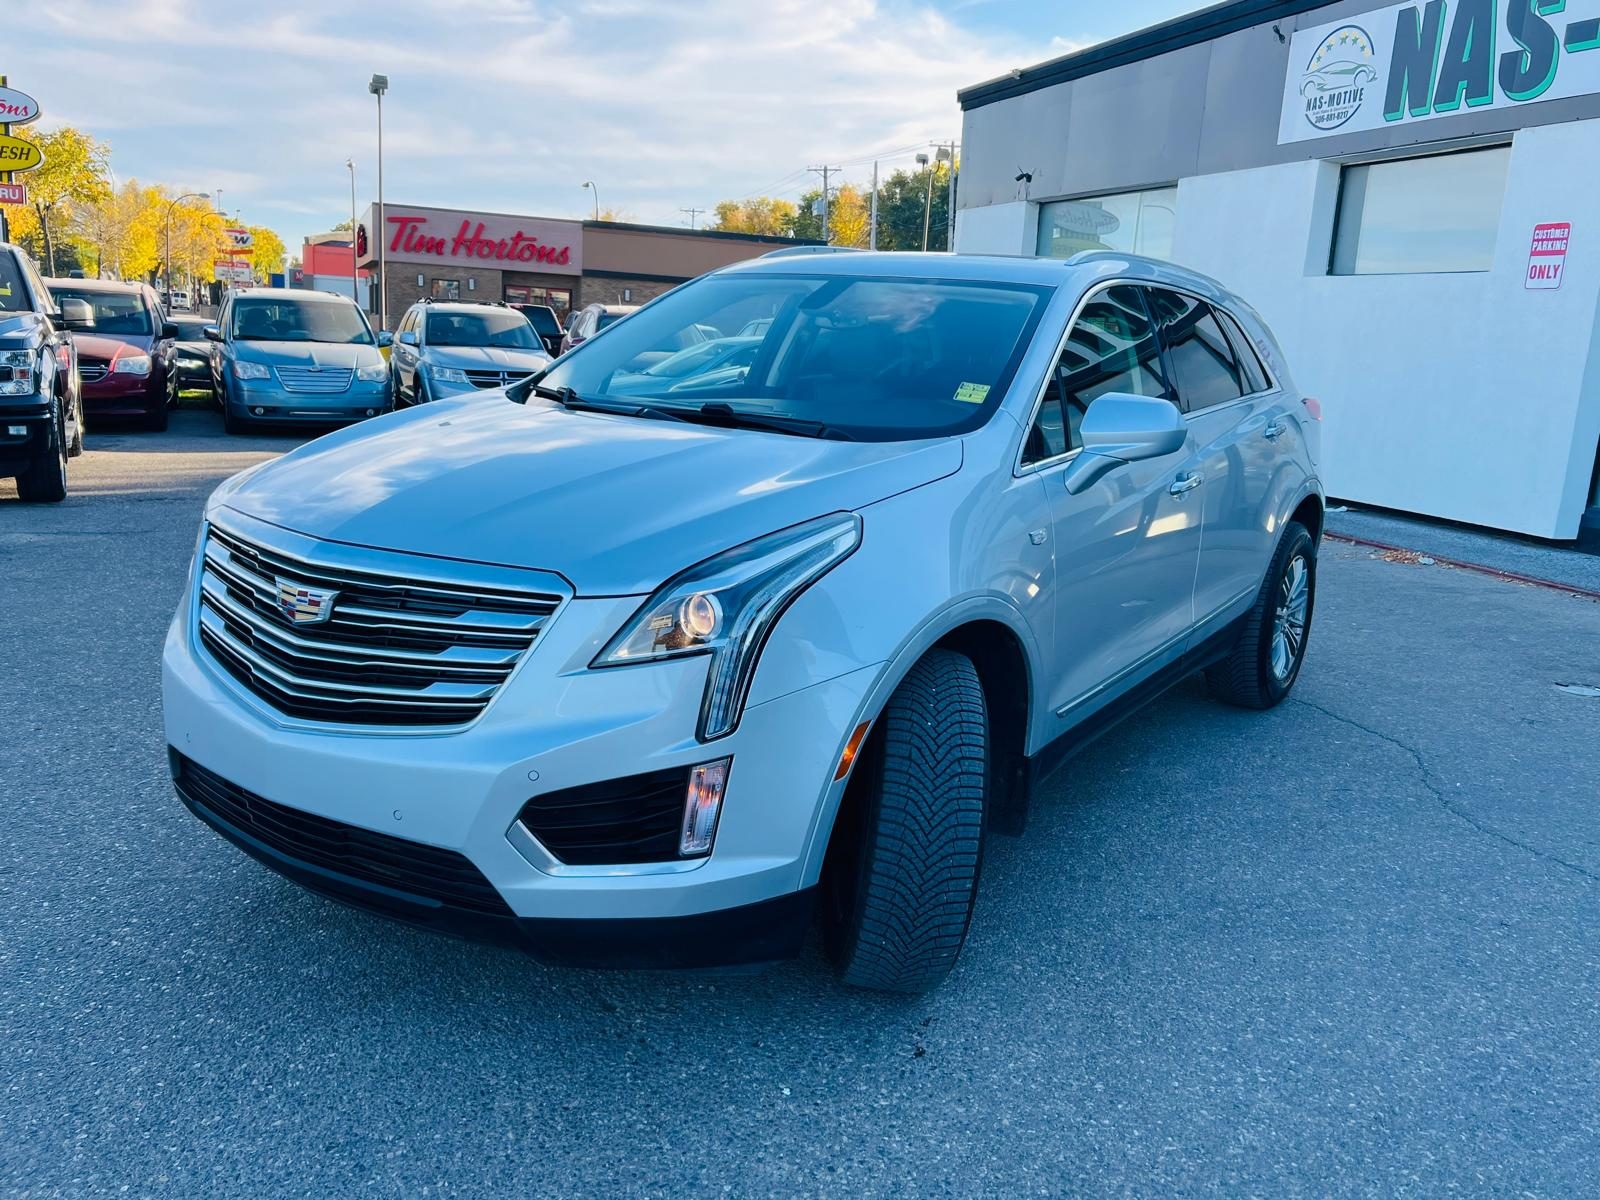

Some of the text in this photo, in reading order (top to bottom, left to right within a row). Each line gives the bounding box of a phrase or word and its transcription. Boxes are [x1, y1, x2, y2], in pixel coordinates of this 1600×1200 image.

[1305, 87, 1364, 112] NAS-MOTIVE
[386, 216, 571, 266] Tim Hortons
[1534, 228, 1570, 239] CUSTOMER
[1531, 239, 1568, 251] PARKING
[1529, 264, 1561, 280] ONLY
